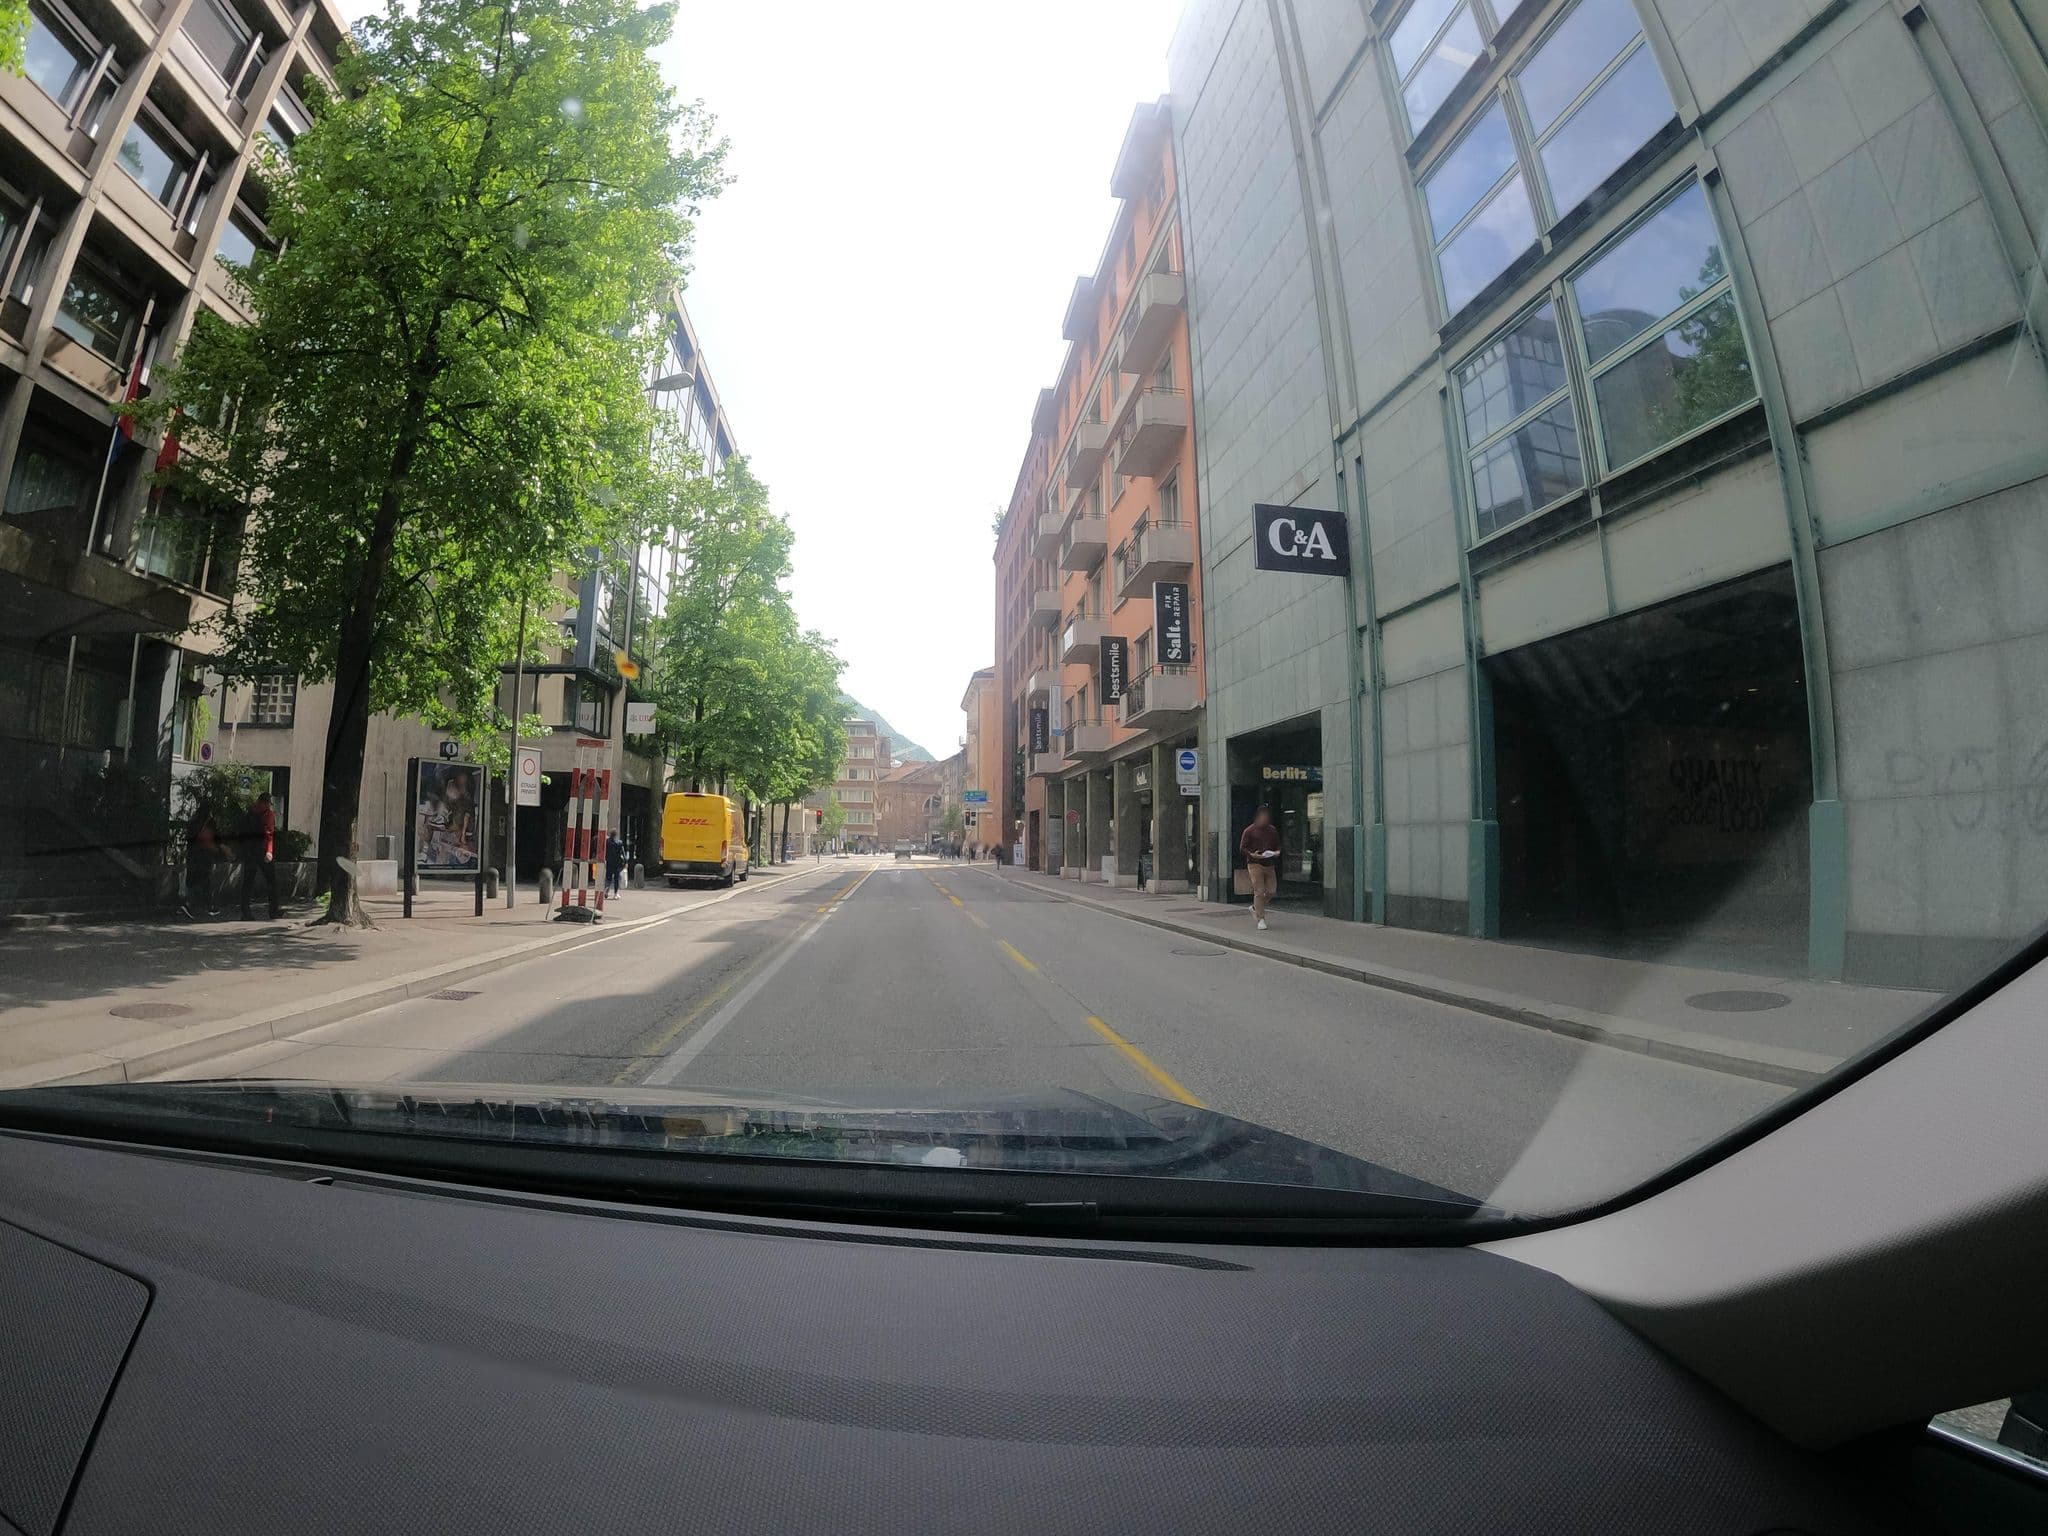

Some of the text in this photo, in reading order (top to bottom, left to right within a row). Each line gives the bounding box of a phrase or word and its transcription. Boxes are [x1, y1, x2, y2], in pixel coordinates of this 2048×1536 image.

[1269, 518, 1337, 560] C&A
[1166, 619, 1182, 659] Salt.
[1109, 642, 1120, 698] bestsmile
[1262, 766, 1308, 780] Berlitz
[678, 817, 709, 826] DHL
